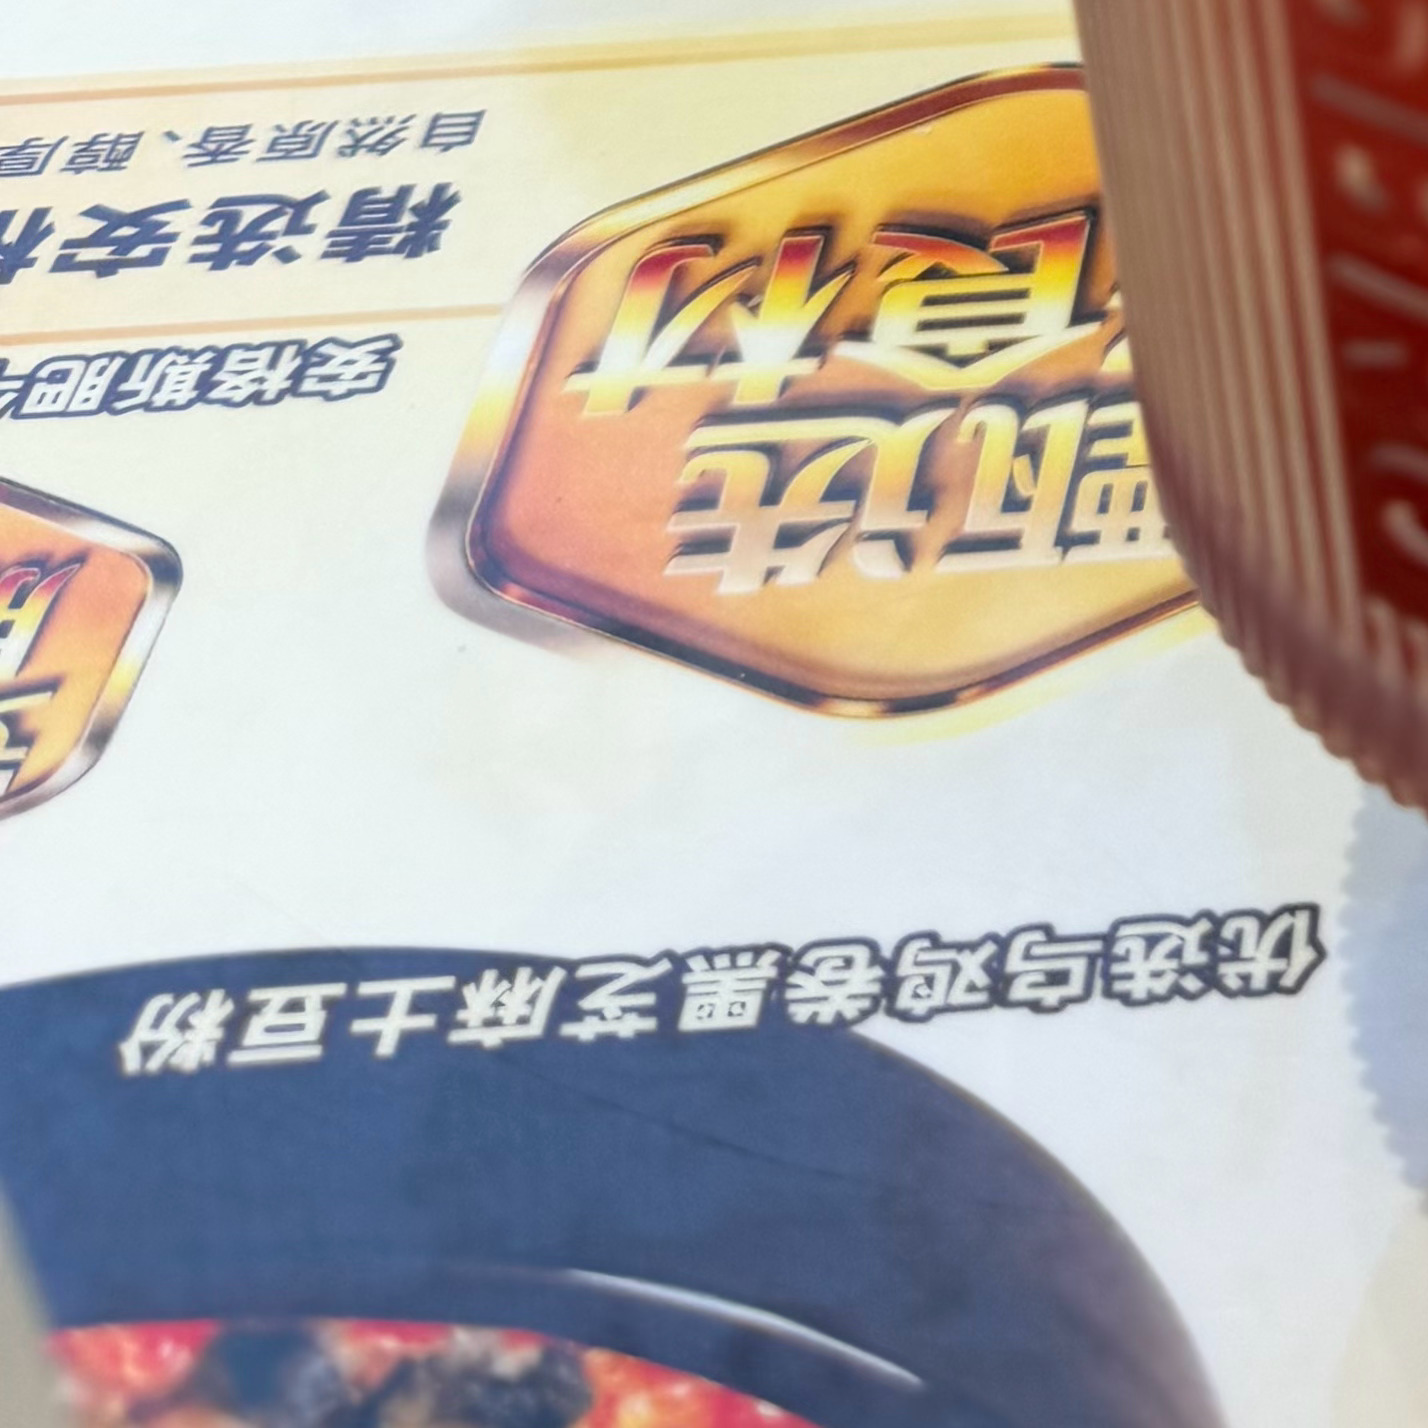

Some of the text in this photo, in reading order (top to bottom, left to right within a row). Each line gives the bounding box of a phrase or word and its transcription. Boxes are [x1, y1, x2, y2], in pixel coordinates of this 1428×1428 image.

[560, 212, 1142, 416] 食材
[116, 902, 1328, 1076] 优选乌鸡卷黑芝麻土豆粉
